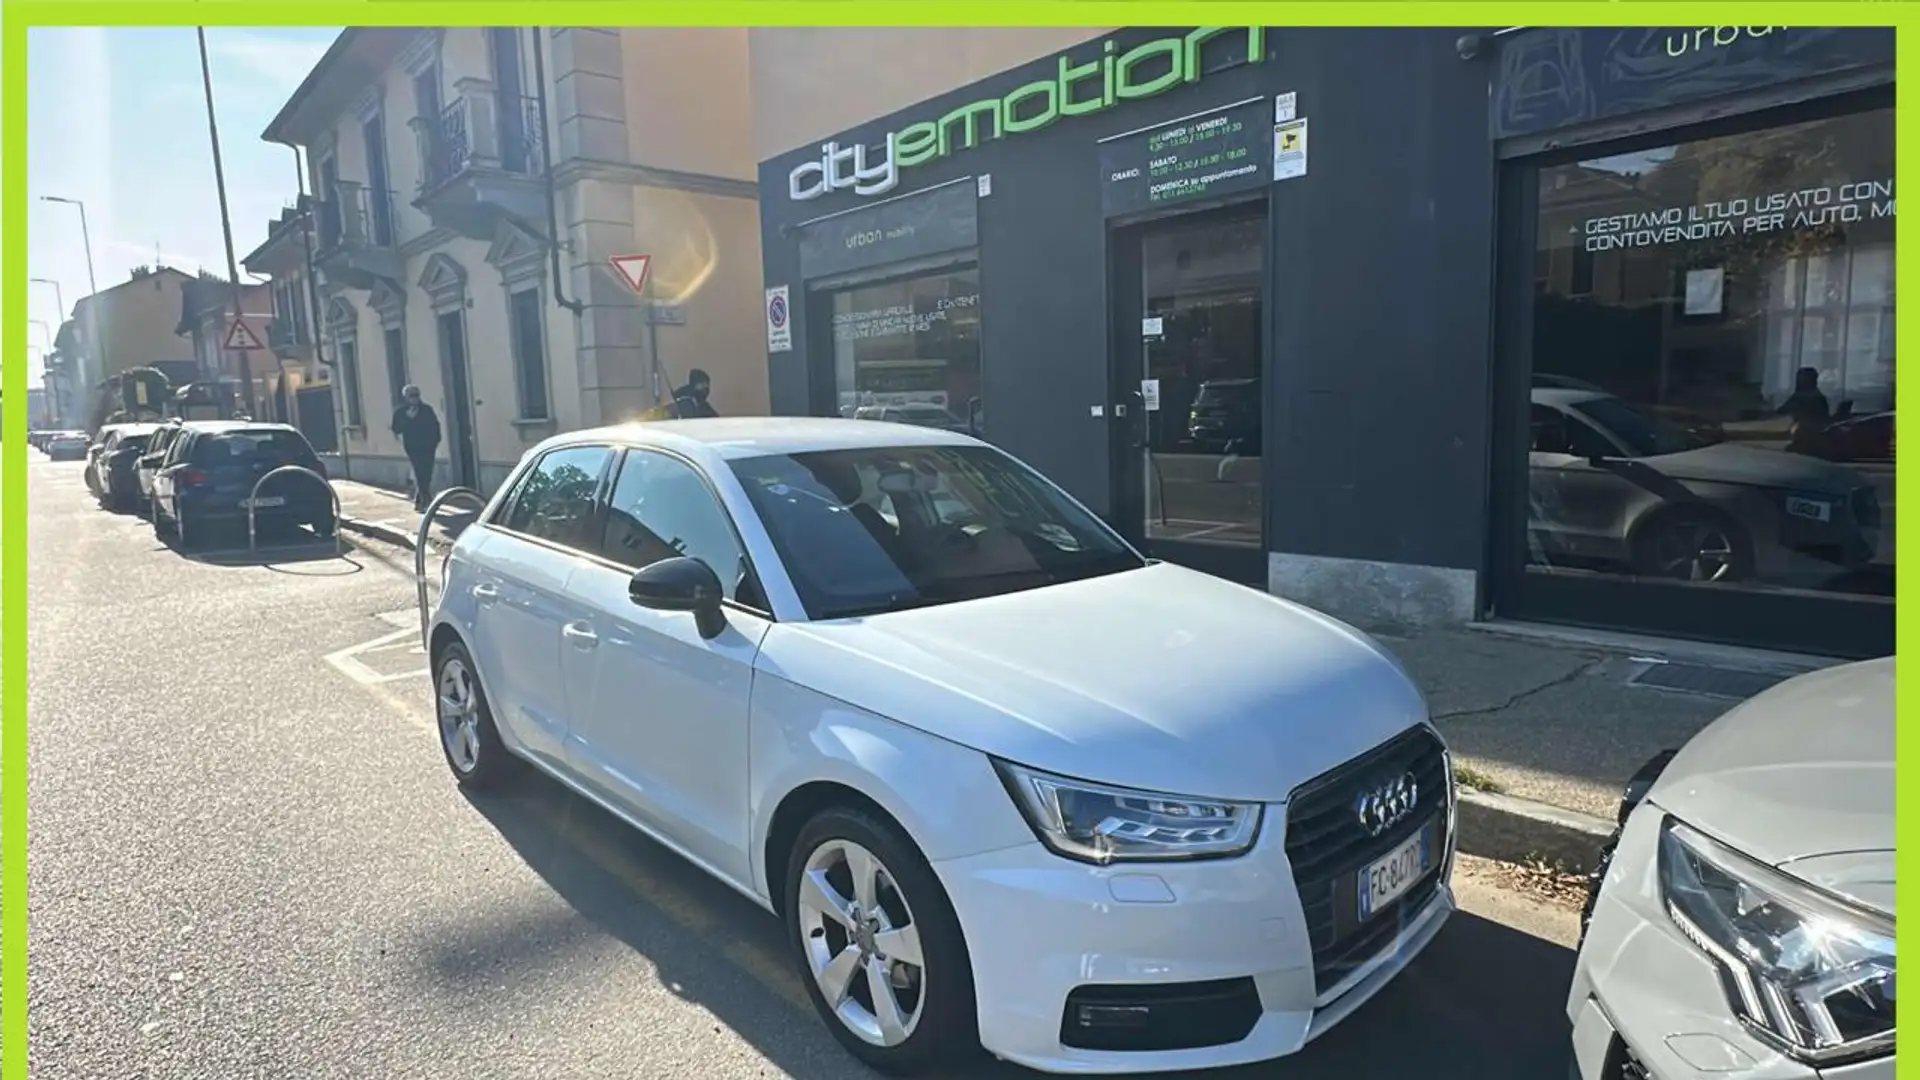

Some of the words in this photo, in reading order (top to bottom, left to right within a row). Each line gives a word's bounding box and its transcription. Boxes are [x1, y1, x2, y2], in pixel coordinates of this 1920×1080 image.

[1667, 26, 1788, 56] urb
[1150, 155, 1178, 170] SABATO
[1586, 207, 1682, 235] GESTIAMO
[1755, 187, 1831, 213] USATO
[1839, 180, 1893, 201] CON
[845, 227, 882, 249] urban
[1586, 221, 1736, 251] CONTOVENDITA
[1743, 213, 1785, 234] PER
[1791, 203, 1863, 228] AUTO,
